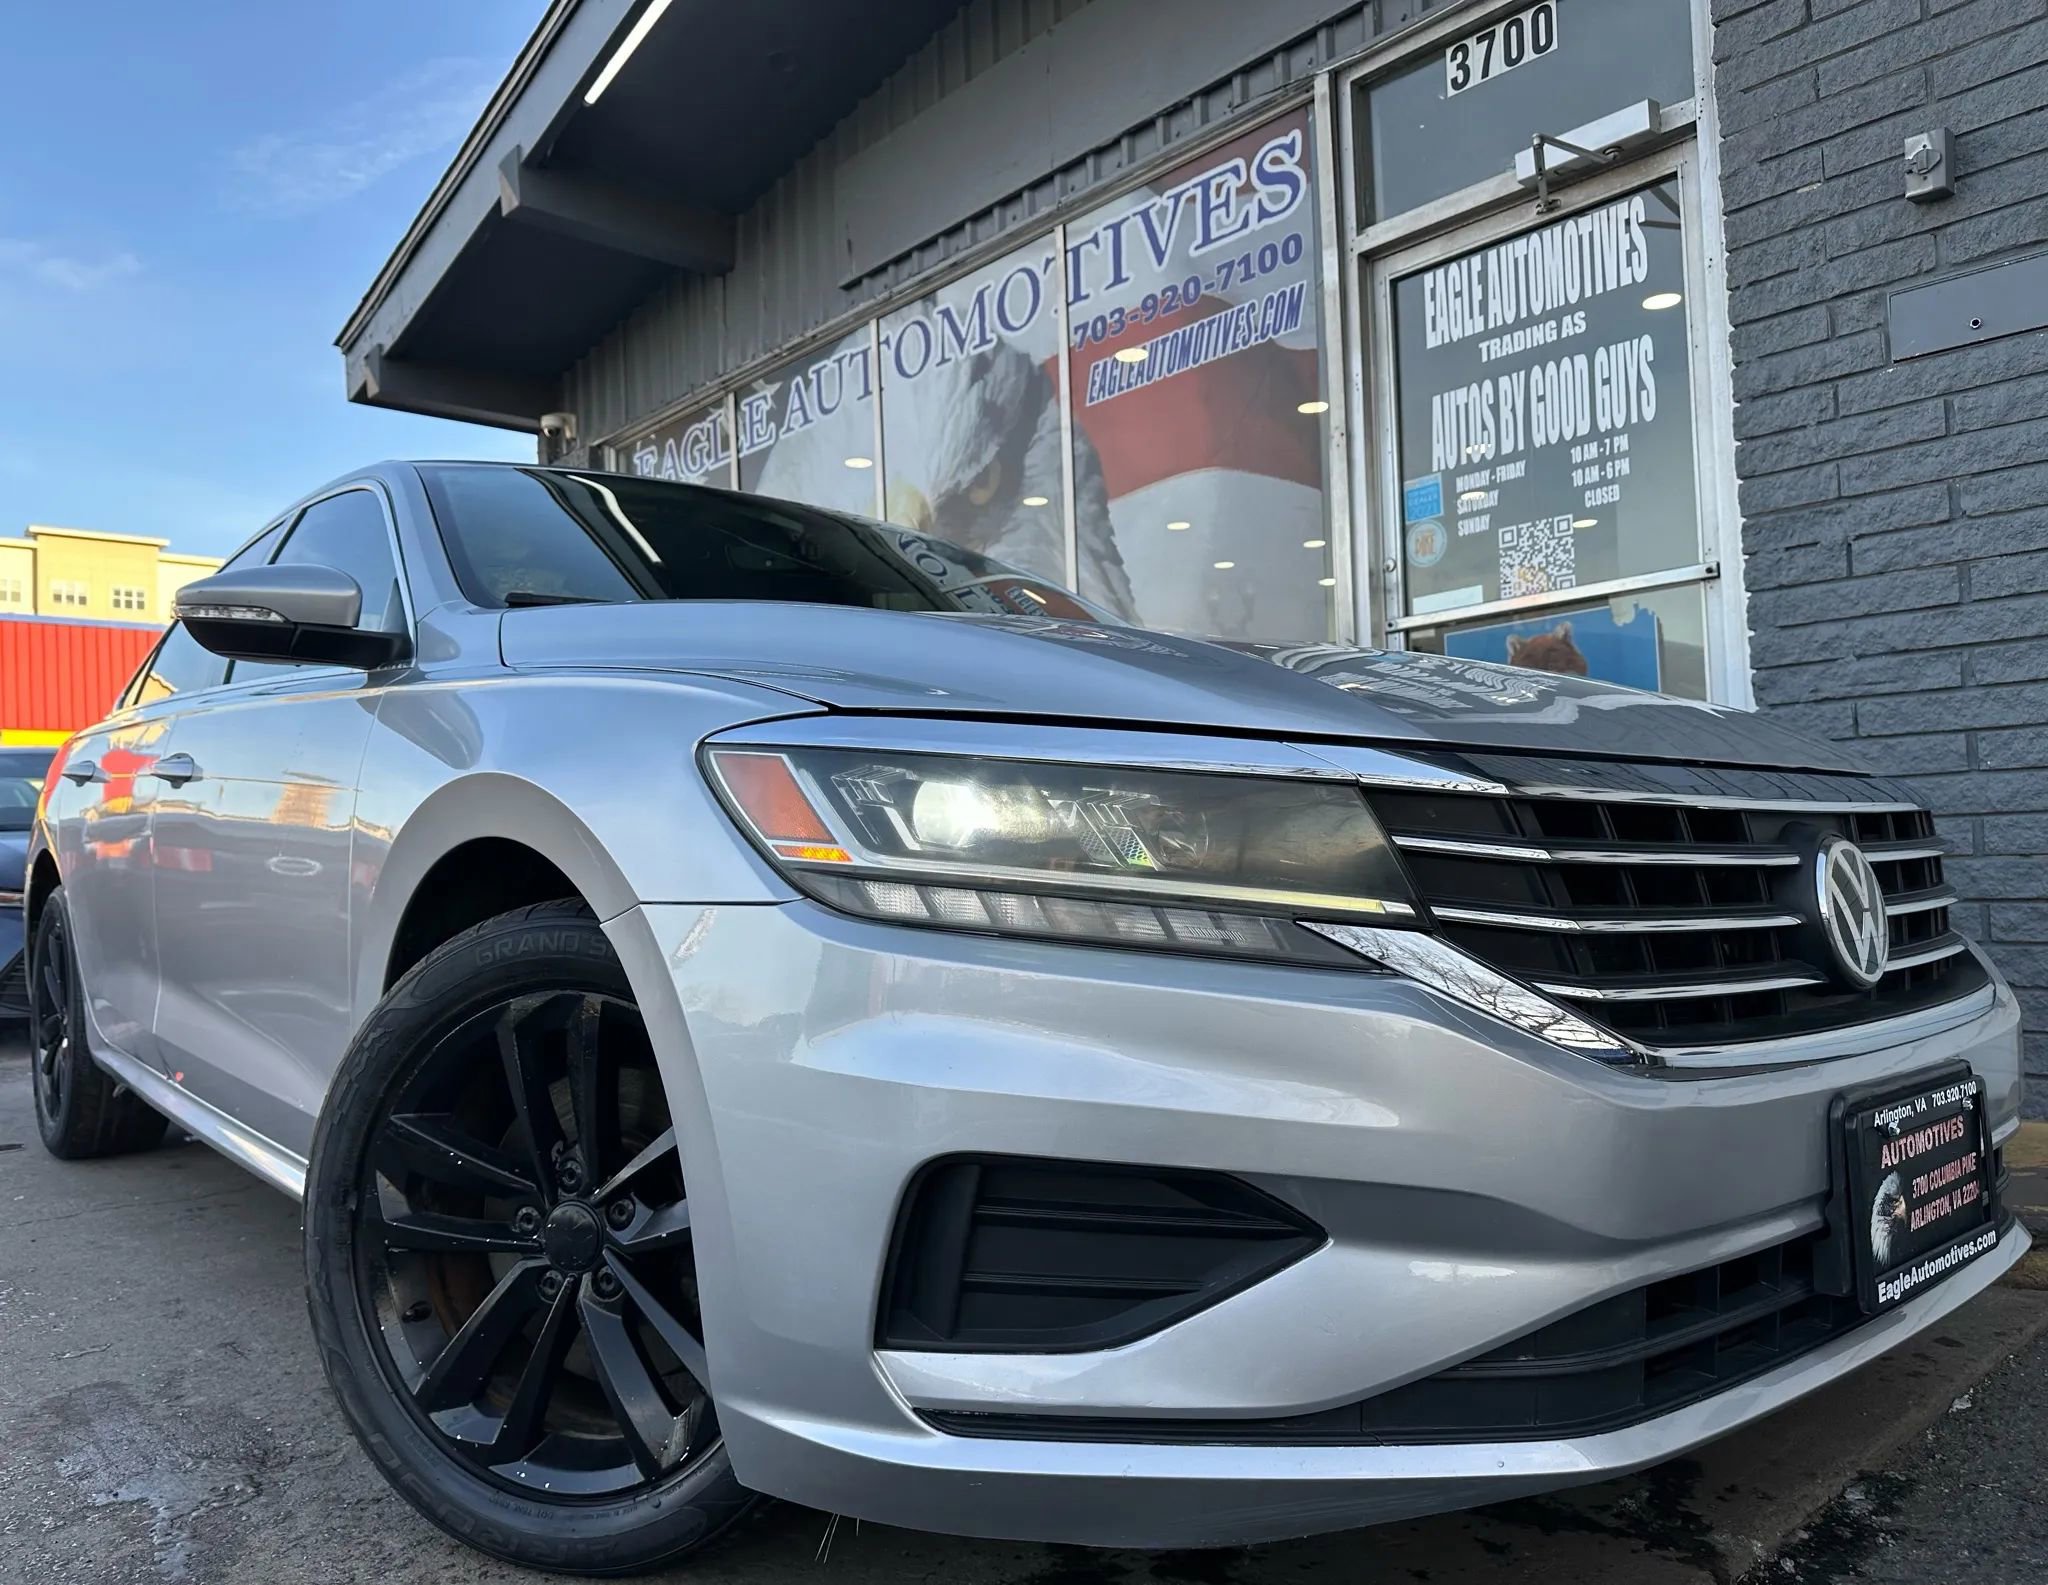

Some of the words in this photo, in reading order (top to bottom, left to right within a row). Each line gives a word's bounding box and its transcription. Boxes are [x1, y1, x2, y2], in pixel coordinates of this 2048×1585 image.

[1450, 4, 1553, 91] 3700
[1074, 233, 1303, 351] 703-920-7100
[1424, 255, 1484, 349] EAGLE
[1488, 196, 1648, 329] AUTOMOTIVES
[633, 392, 777, 479] EAGLE
[781, 129, 1306, 439] AUTOMOTIVES
[1086, 281, 1306, 407] EAGLEAUTOMOTIVES.COM
[1479, 320, 1557, 362] TRADING
[1561, 311, 1586, 338] AS
[1432, 379, 1495, 472] AUTOS
[1498, 370, 1525, 455] BY
[1530, 354, 1590, 448] GOOD
[1595, 334, 1656, 432] GUYS
[1571, 446, 1582, 464] 10
[1583, 441, 1598, 461] AM
[1604, 438, 1610, 456] 7
[1614, 434, 1629, 453] PM
[1571, 468, 1583, 487] 10
[1584, 465, 1599, 485] AM
[1606, 461, 1613, 479] 6
[1614, 457, 1630, 477] PM
[1456, 470, 1490, 493] MONDAY
[1496, 460, 1526, 483] FRIDAY
[1584, 484, 1620, 508] CLOSED
[1457, 489, 1499, 515] SATURDAY
[1457, 514, 1491, 537] SUNDAY
[1874, 1105, 1914, 1128] Arlington,
[1915, 1097, 1927, 1113] VA
[1932, 1081, 1977, 1108] 703.920.7100
[1881, 1115, 1964, 1169] AUTOMOTIVES
[1912, 1175, 1929, 1199] 3700
[1929, 1158, 1963, 1191] COLUMBIA
[1962, 1152, 1977, 1176] PIKE
[1911, 1195, 1952, 1232] ARLINGTON,
[1952, 1188, 1963, 1211] VA
[1878, 1229, 1996, 1304] EagleAutomotives.com
